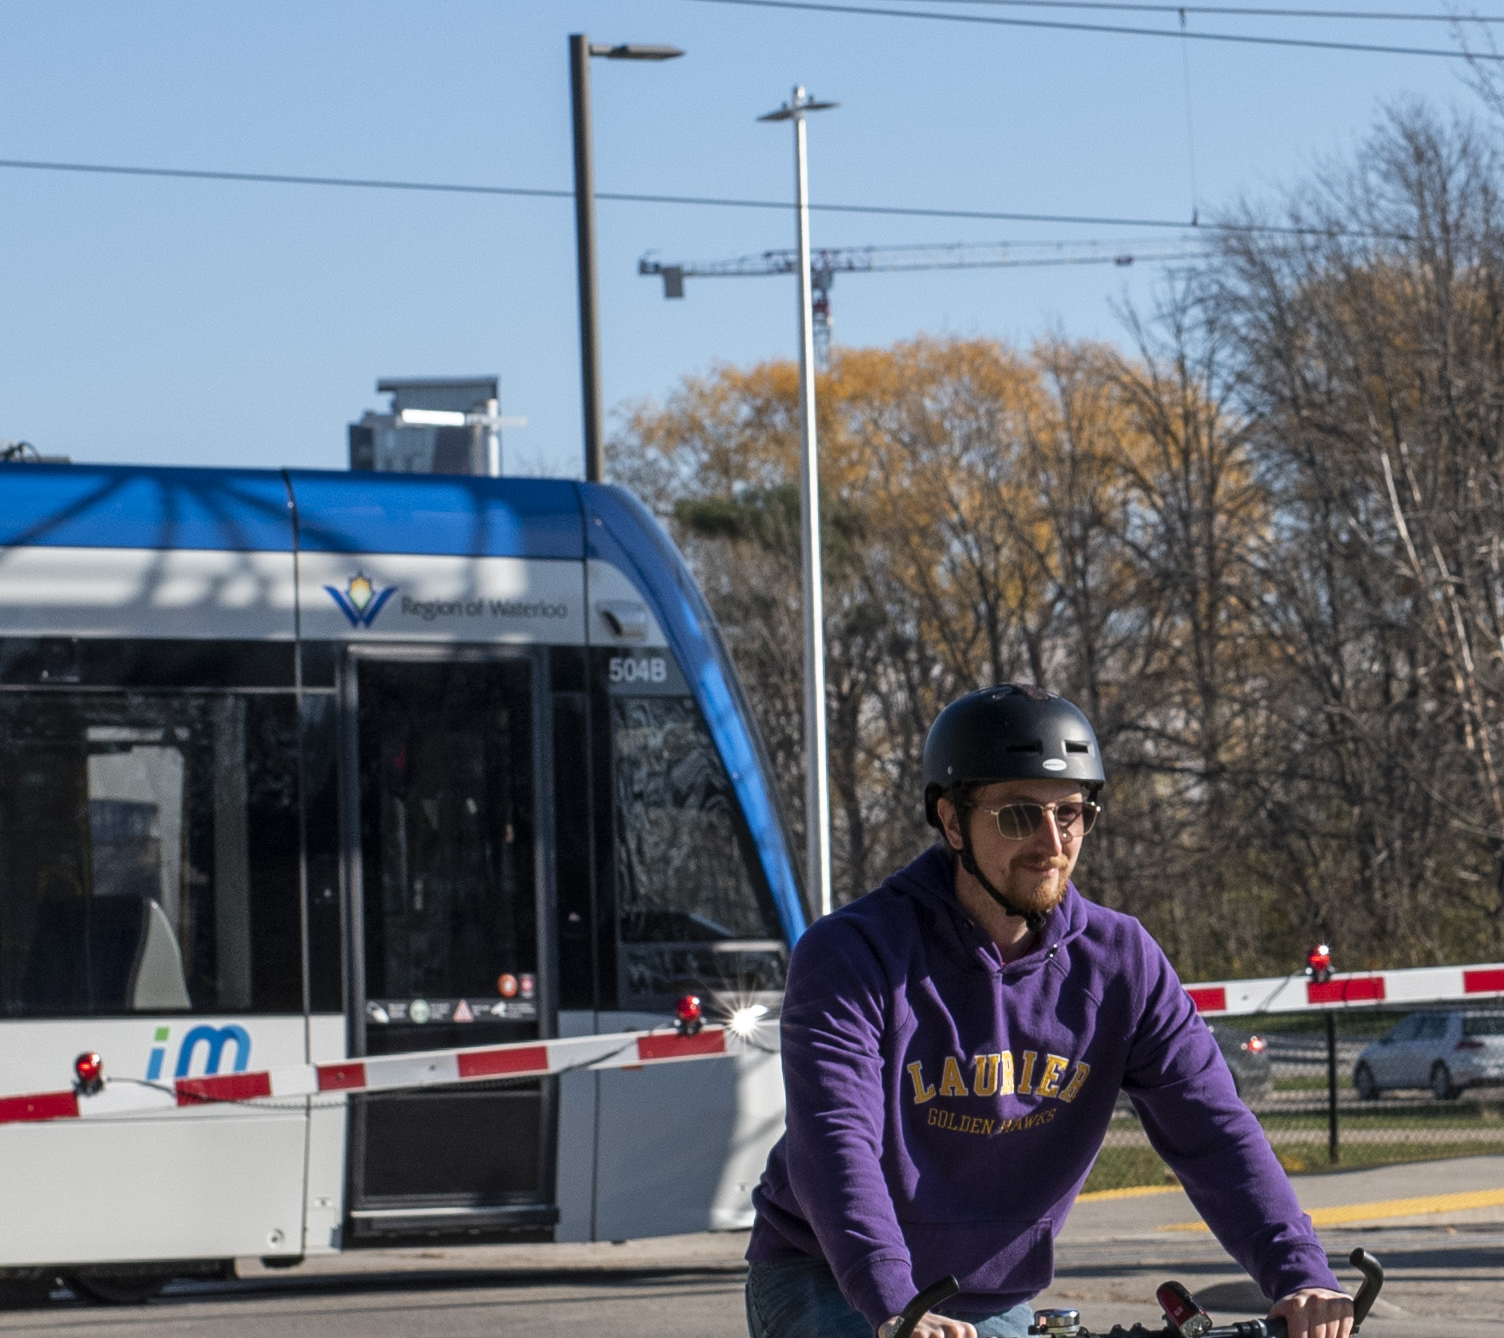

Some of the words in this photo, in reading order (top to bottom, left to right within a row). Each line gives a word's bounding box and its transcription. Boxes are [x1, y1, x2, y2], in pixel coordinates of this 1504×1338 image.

[400, 597, 464, 622] Region
[466, 599, 484, 614] of
[489, 600, 569, 619] Waterloo
[608, 657, 667, 683] 504B
[906, 1050, 1091, 1104] LAURIER
[927, 1107, 996, 1135] GOLDEN
[998, 1108, 1058, 1134] HAWKS
